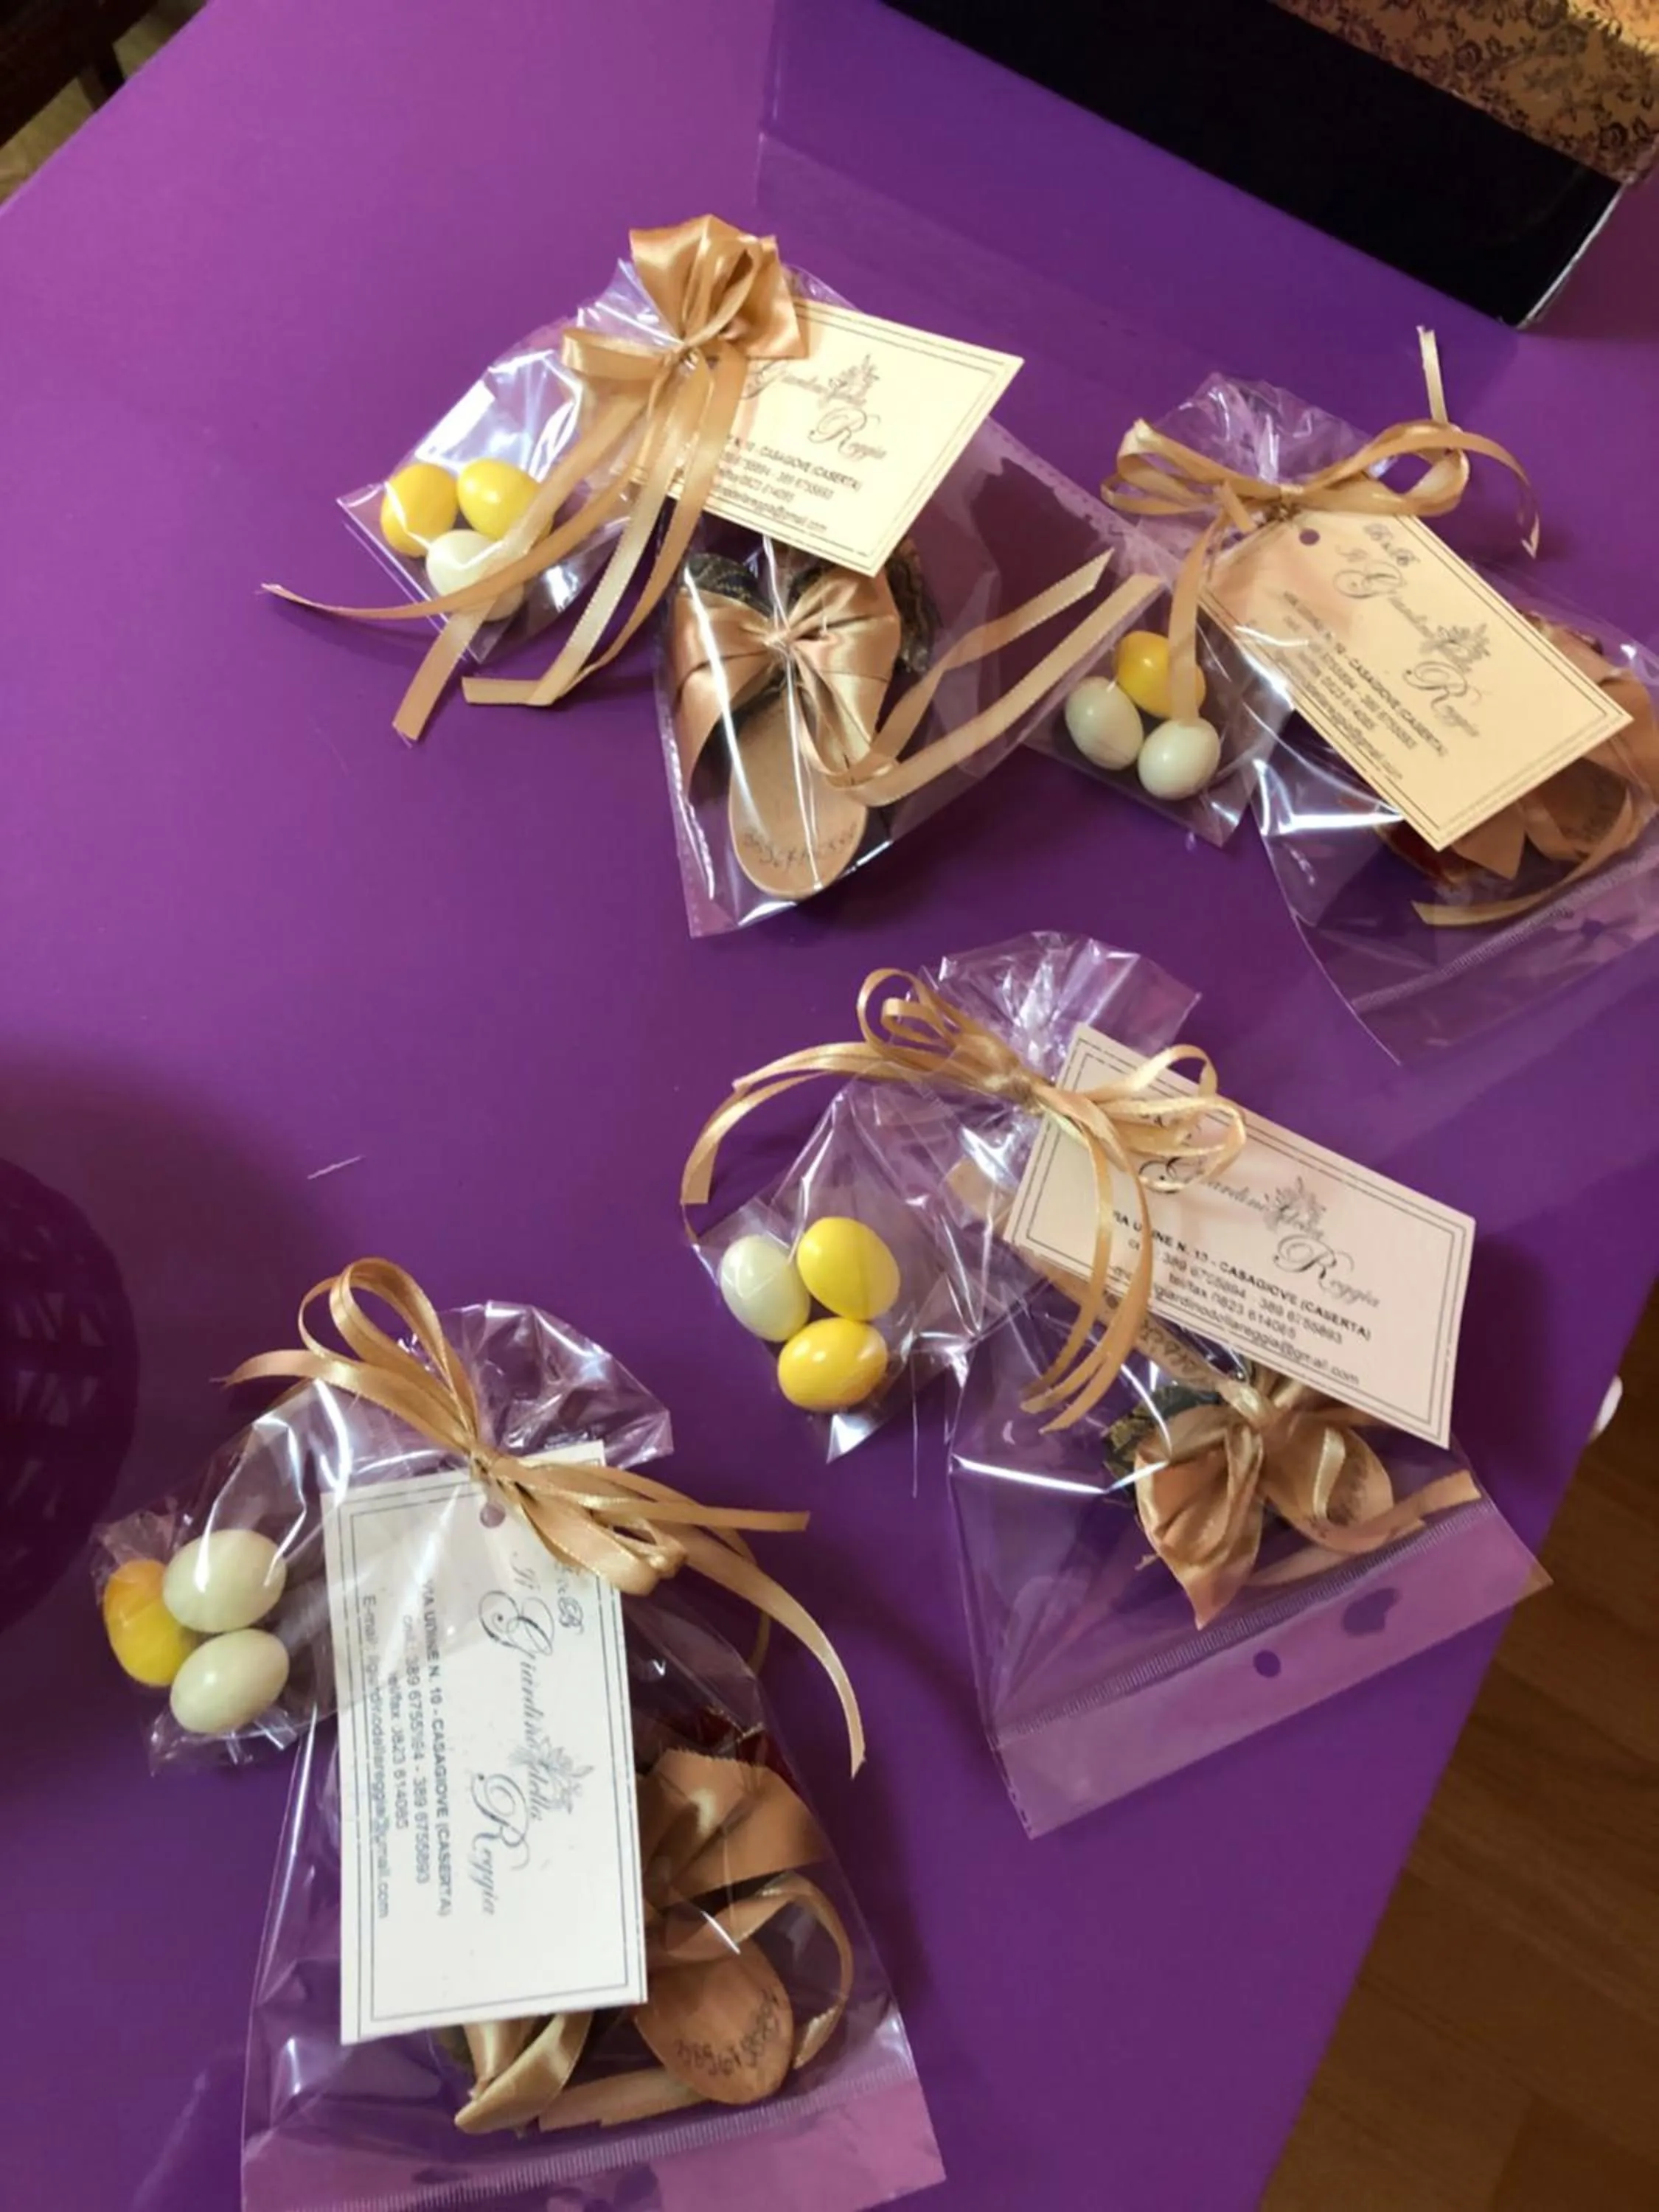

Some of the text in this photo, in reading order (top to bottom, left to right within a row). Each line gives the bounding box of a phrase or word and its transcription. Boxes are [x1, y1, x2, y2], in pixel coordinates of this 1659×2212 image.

[1217, 1259, 1298, 1307] CASAGIOVE
[1299, 1297, 1371, 1343] (CASERTA)
[1273, 1225, 1381, 1309] Reggia
[478, 1589, 554, 1747] Giardino
[430, 1717, 450, 1819] CASAGIOVE
[434, 1821, 453, 1918] (CASERTA)
[470, 1772, 529, 1917] Reggia
